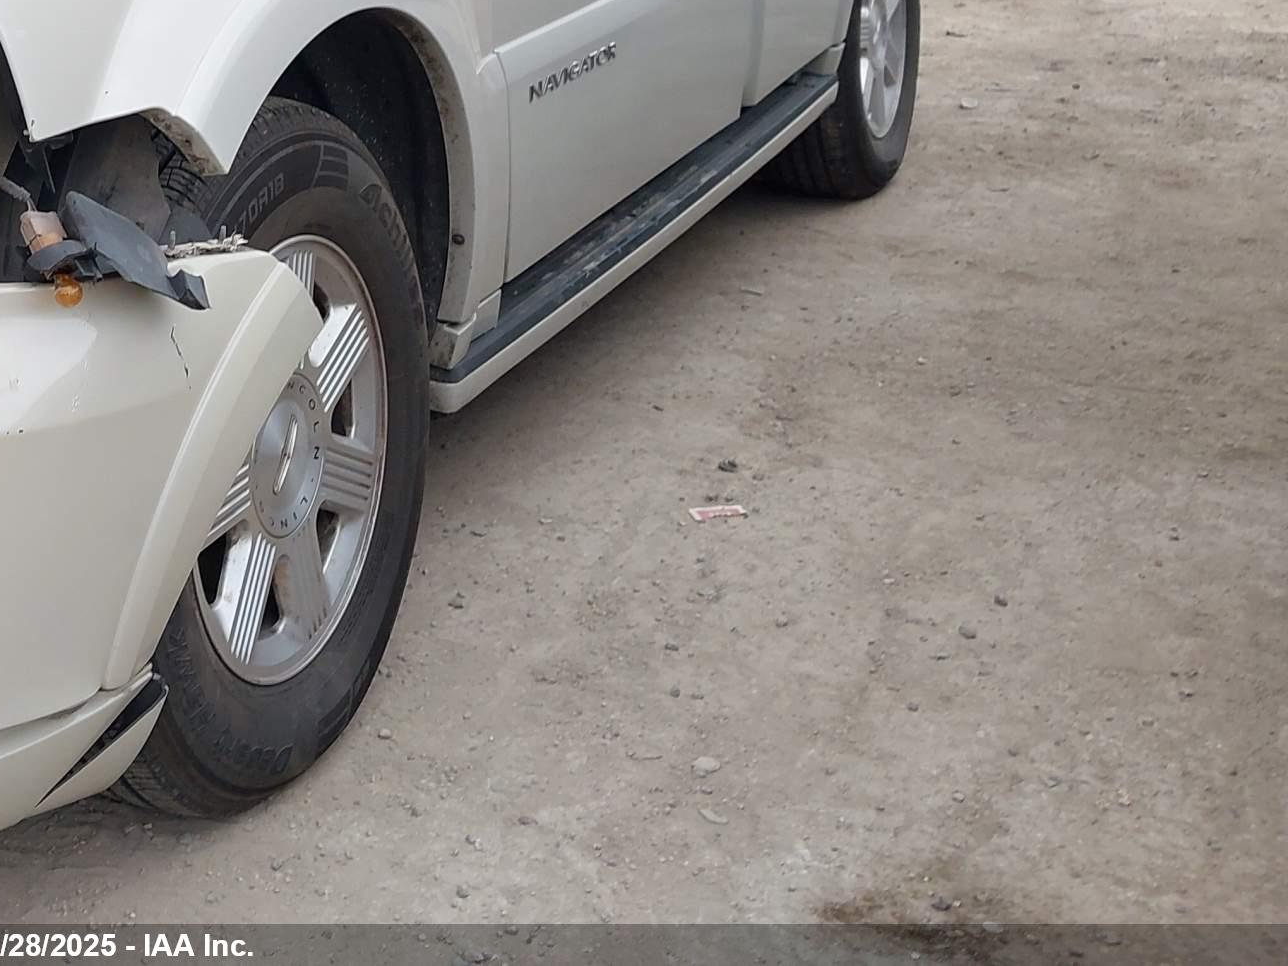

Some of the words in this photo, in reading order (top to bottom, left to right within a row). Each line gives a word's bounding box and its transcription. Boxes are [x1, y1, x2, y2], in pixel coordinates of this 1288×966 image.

[529, 42, 617, 103] NAVIGATOR
[237, 172, 285, 236] 70R18
[286, 381, 321, 460] NCOLN
